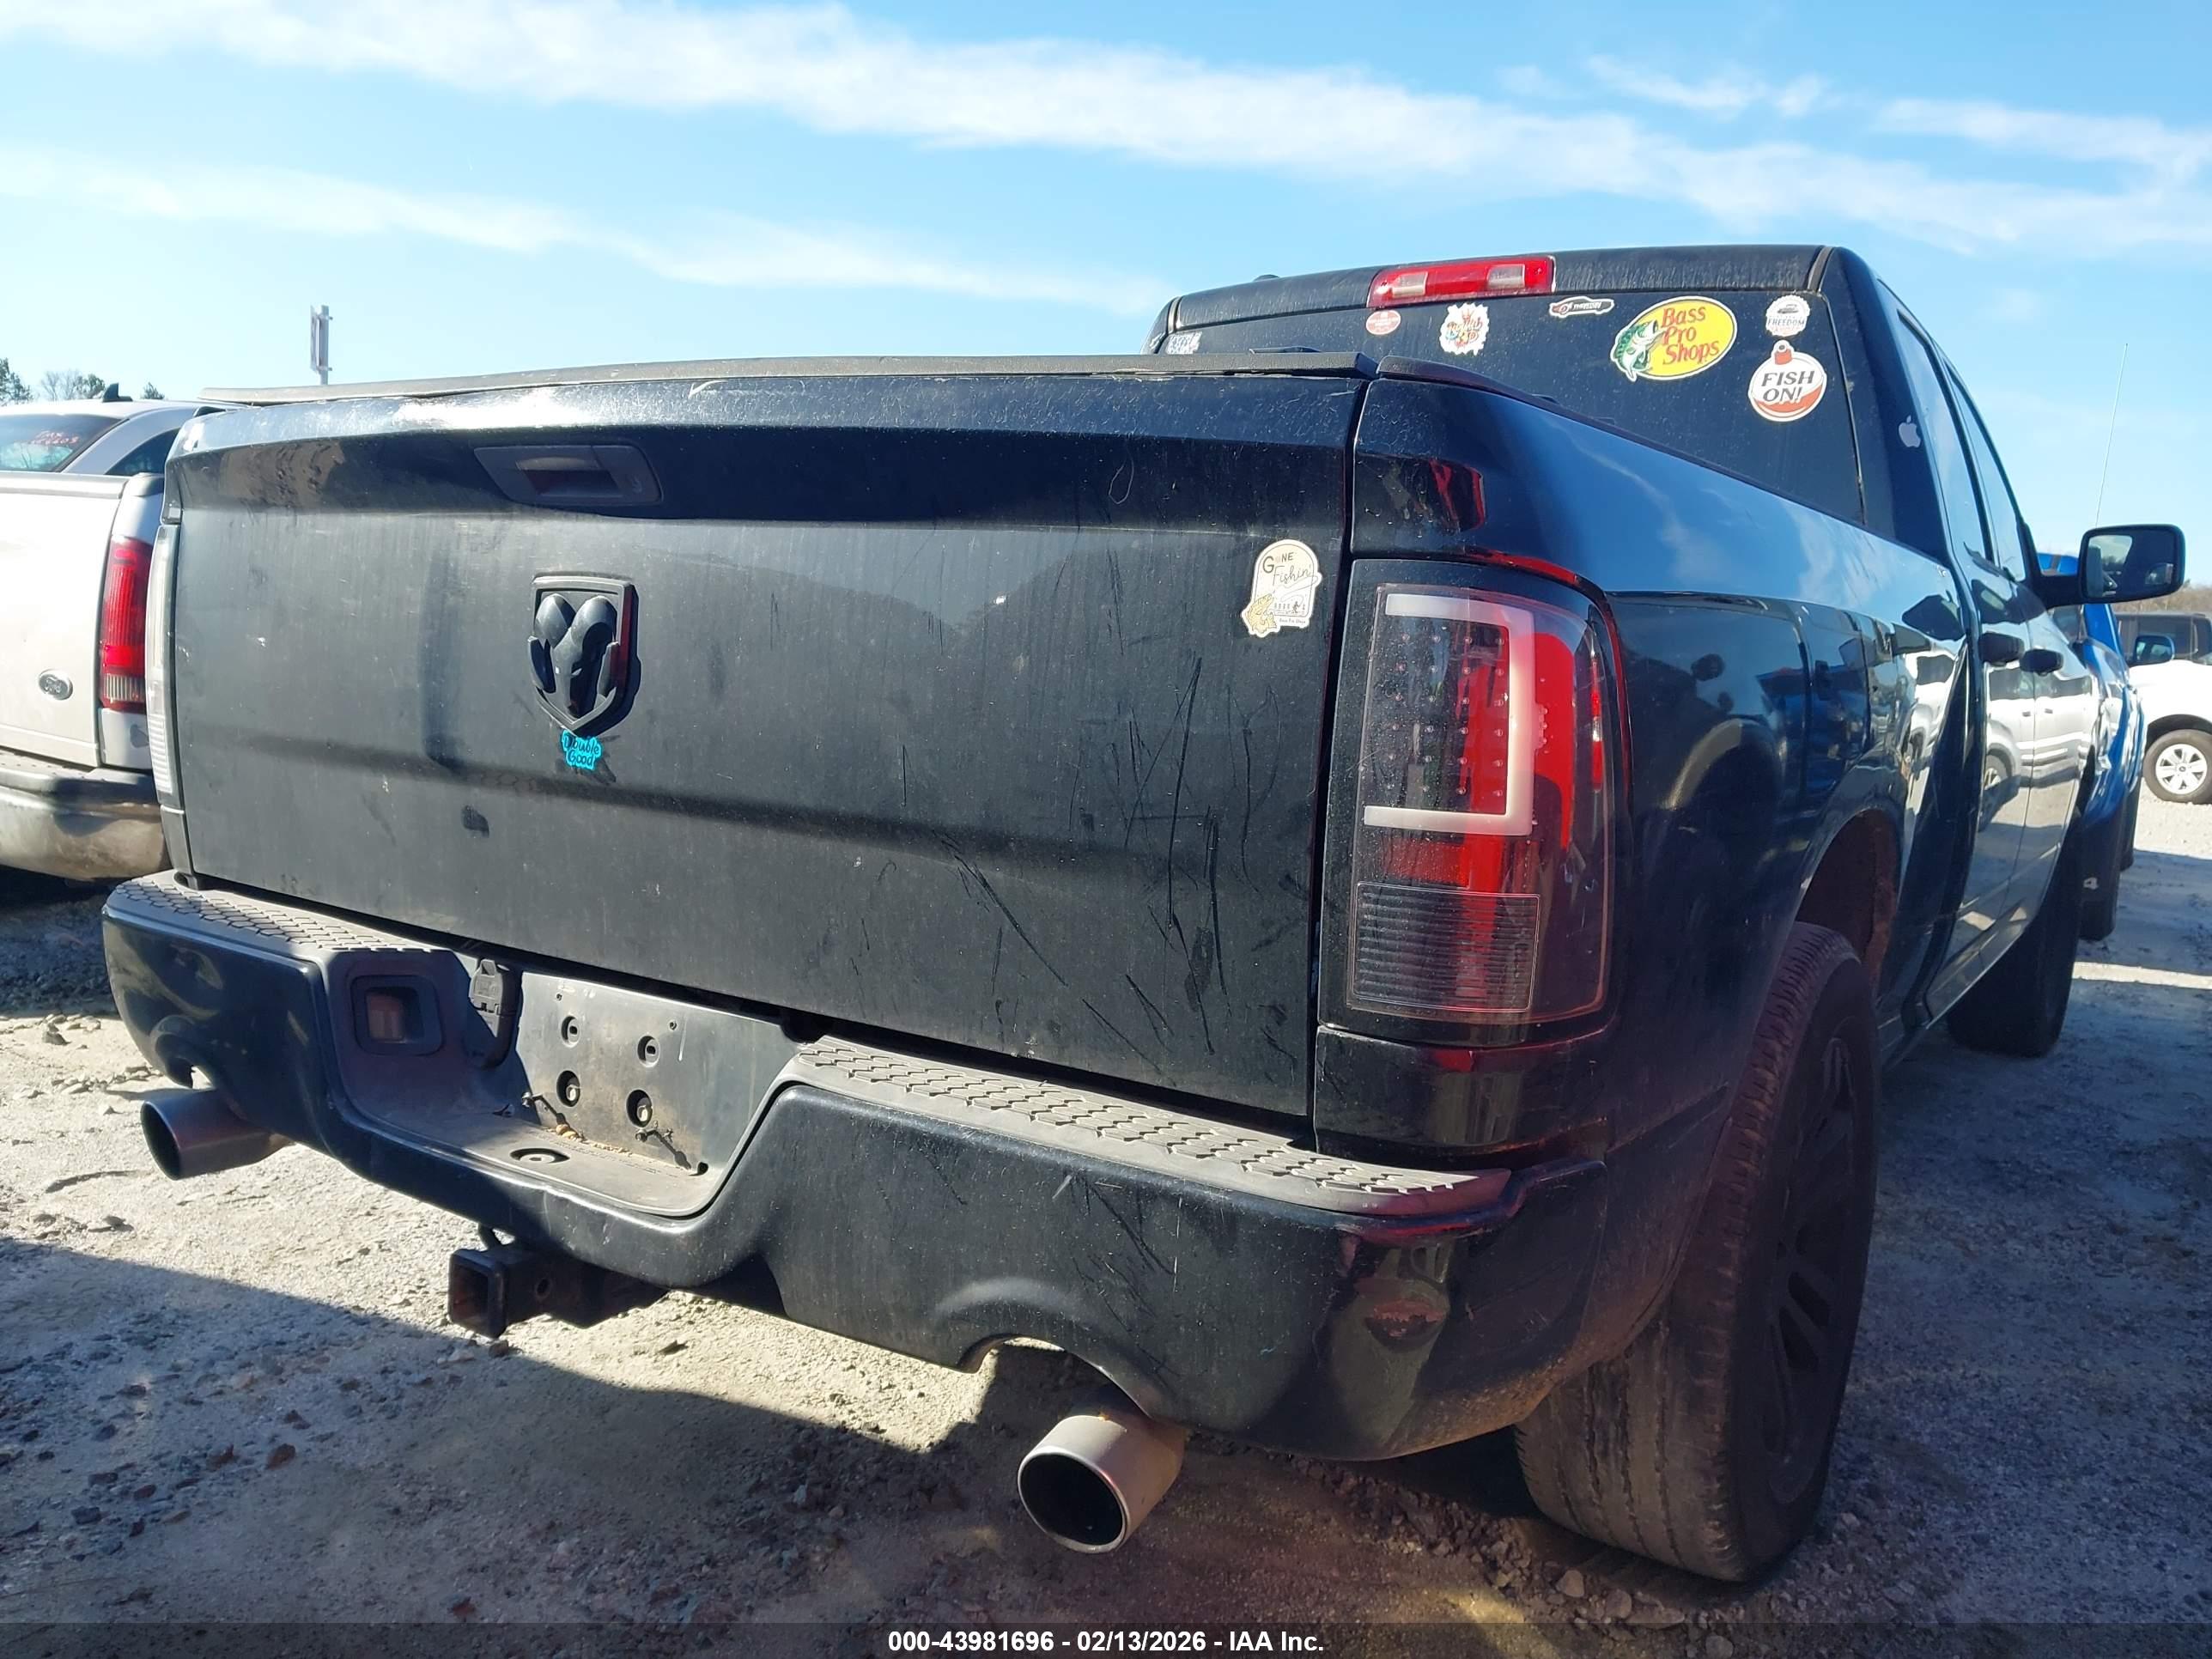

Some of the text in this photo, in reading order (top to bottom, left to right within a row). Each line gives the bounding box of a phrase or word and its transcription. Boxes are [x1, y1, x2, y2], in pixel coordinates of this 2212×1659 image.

[1661, 307, 1706, 328] Bass
[1662, 326, 1697, 346] Pro
[1662, 341, 1720, 365] Shops
[1761, 370, 1814, 386] FISH
[1763, 386, 1802, 402] ON!
[563, 732, 599, 755] Double
[568, 750, 593, 765] Good
